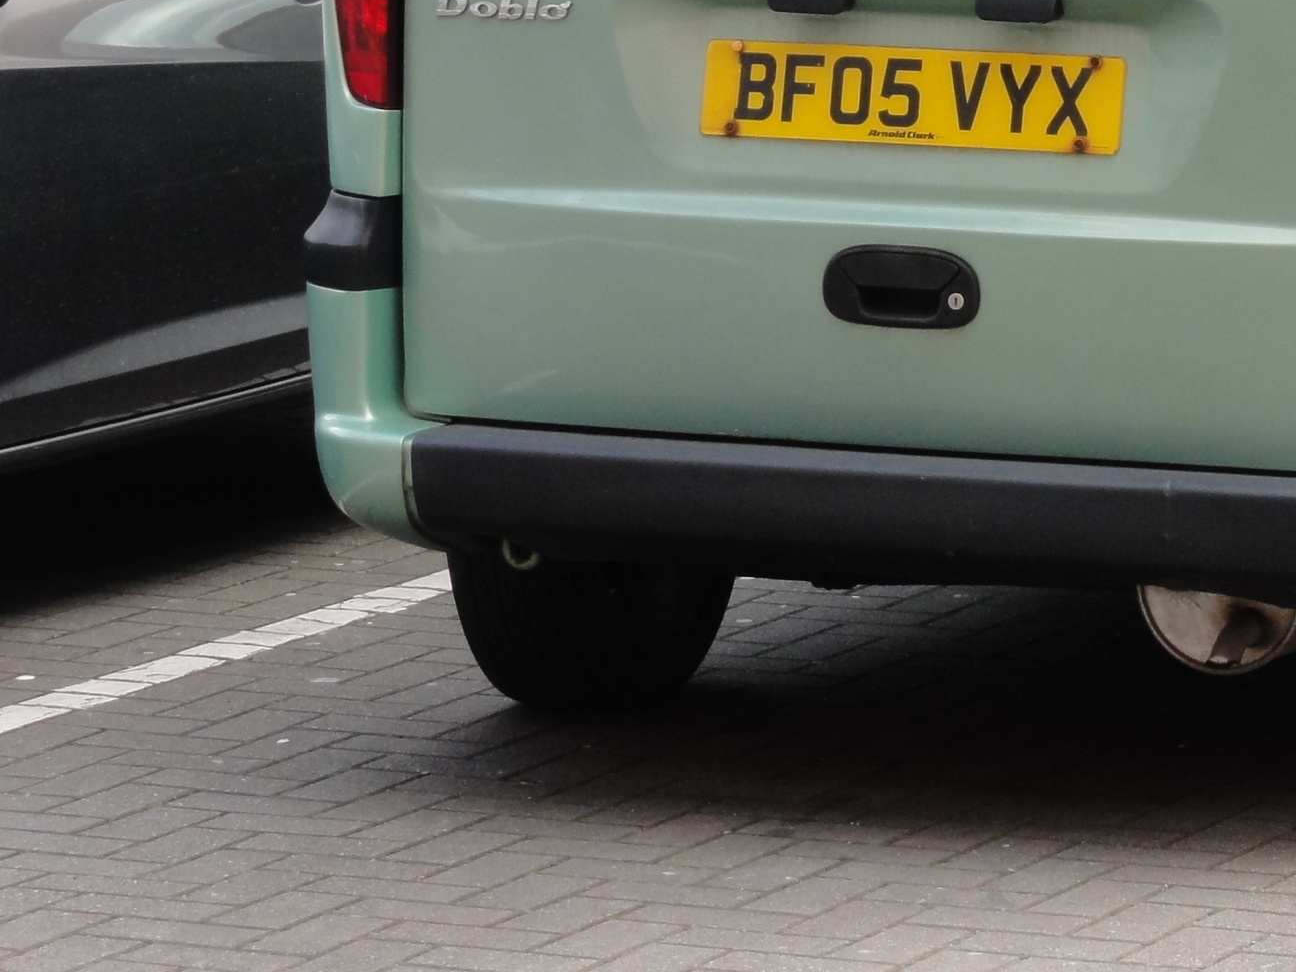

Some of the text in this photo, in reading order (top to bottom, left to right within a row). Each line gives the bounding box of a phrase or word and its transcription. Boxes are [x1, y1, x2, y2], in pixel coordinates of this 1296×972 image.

[734, 52, 1094, 137] BF05 VYX
[868, 129, 935, 140] Arnold Clark
